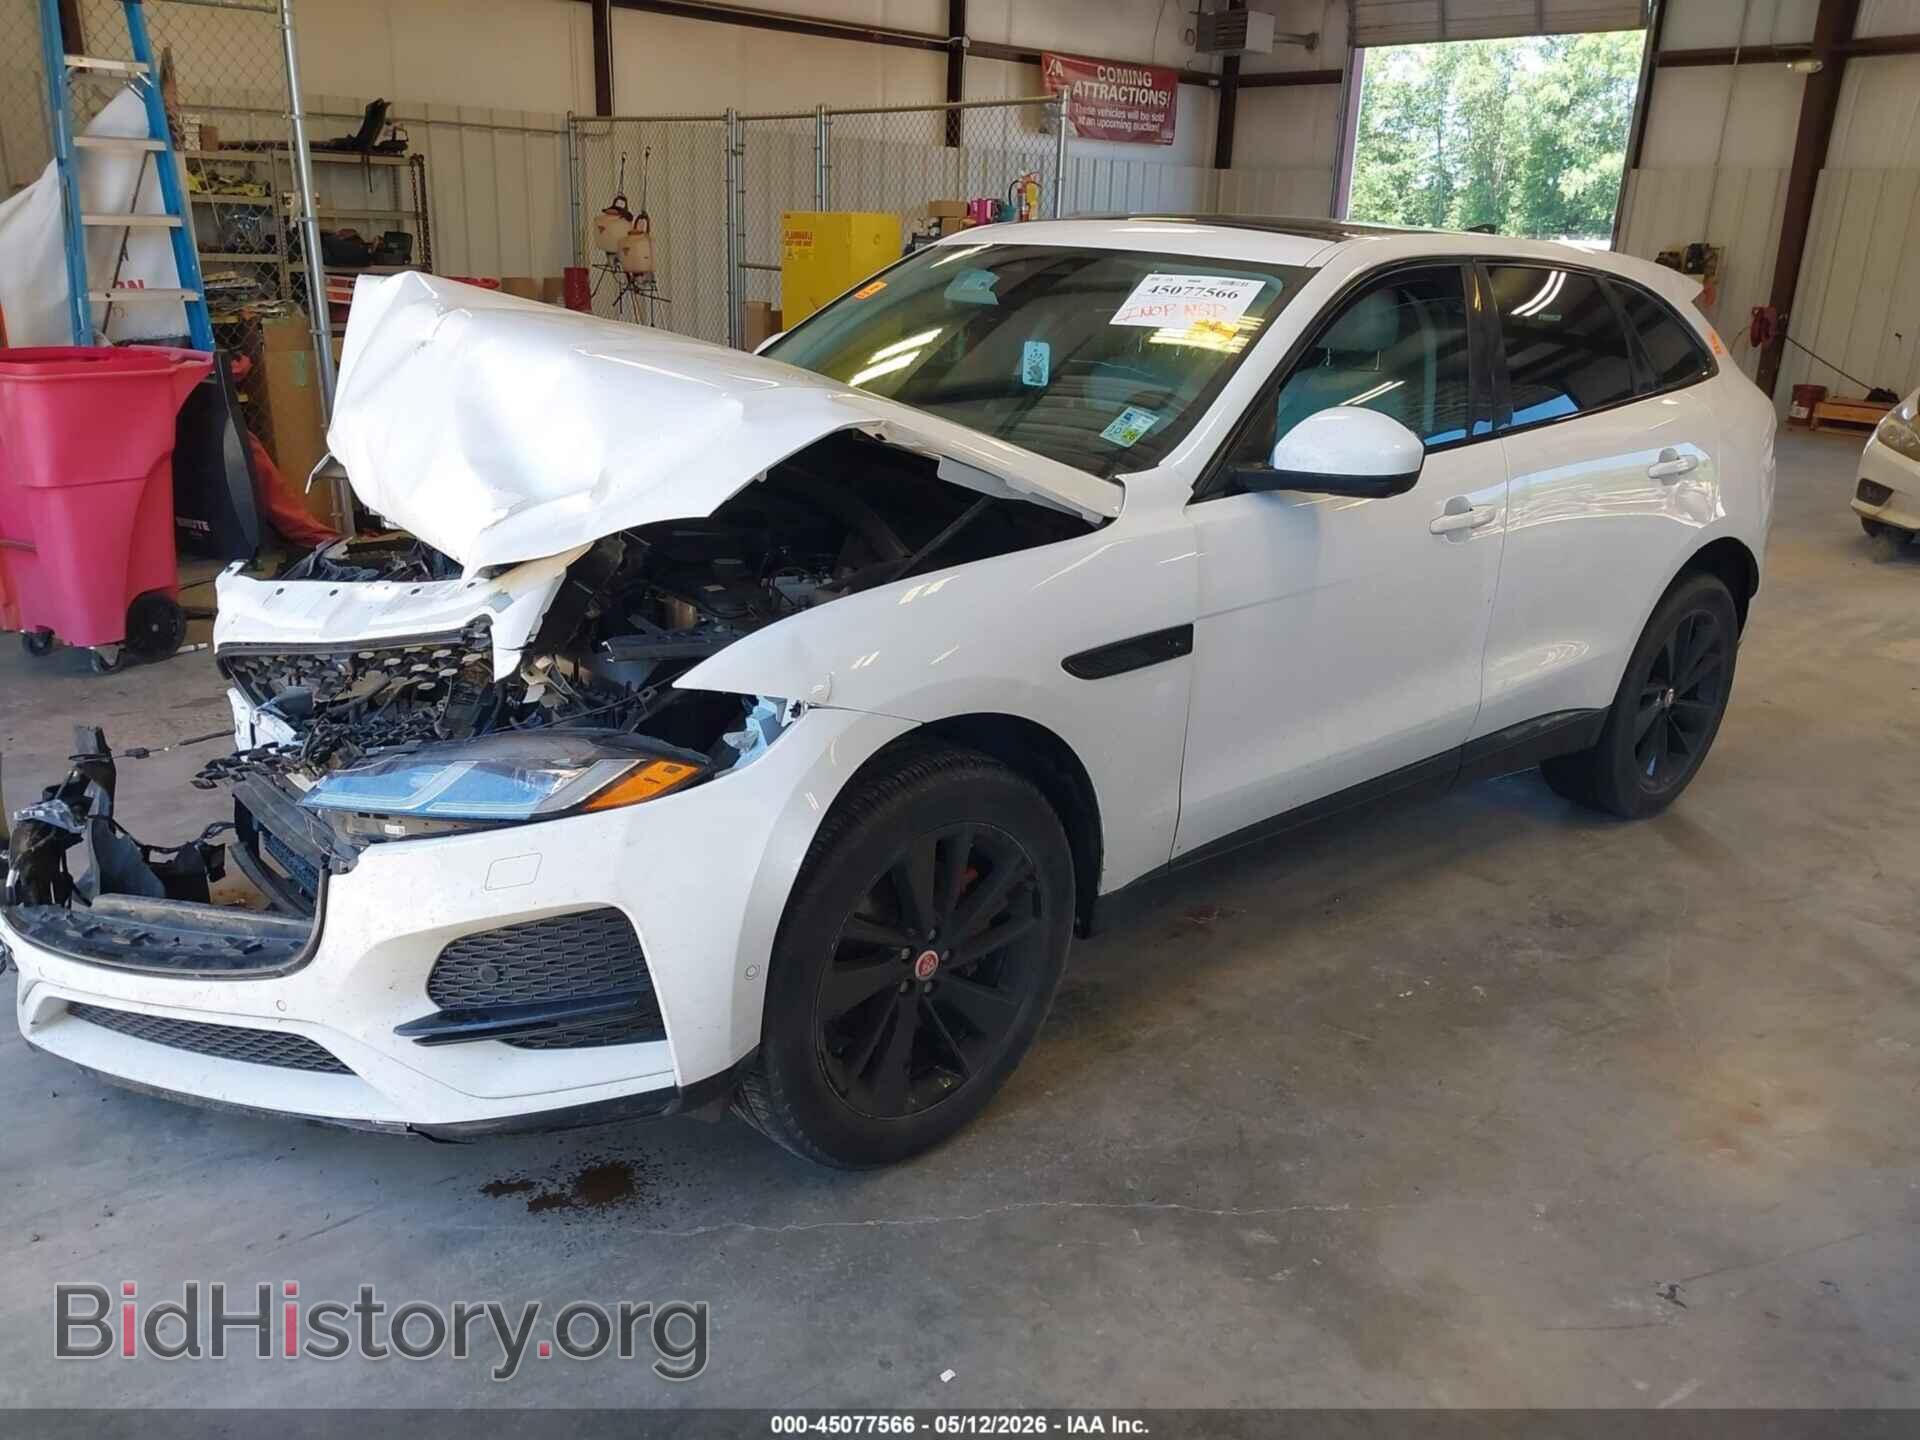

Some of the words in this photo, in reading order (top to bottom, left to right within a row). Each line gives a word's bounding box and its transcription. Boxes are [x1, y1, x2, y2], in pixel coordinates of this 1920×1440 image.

[1097, 65, 1153, 88] COMING
[1072, 80, 1172, 108] ATTRACTIONS!
[1098, 106, 1126, 119] vehicles
[1140, 109, 1151, 120] be
[1151, 112, 1165, 123] sold
[1097, 117, 1132, 133] upcoming
[1148, 284, 1239, 300] 45077566
